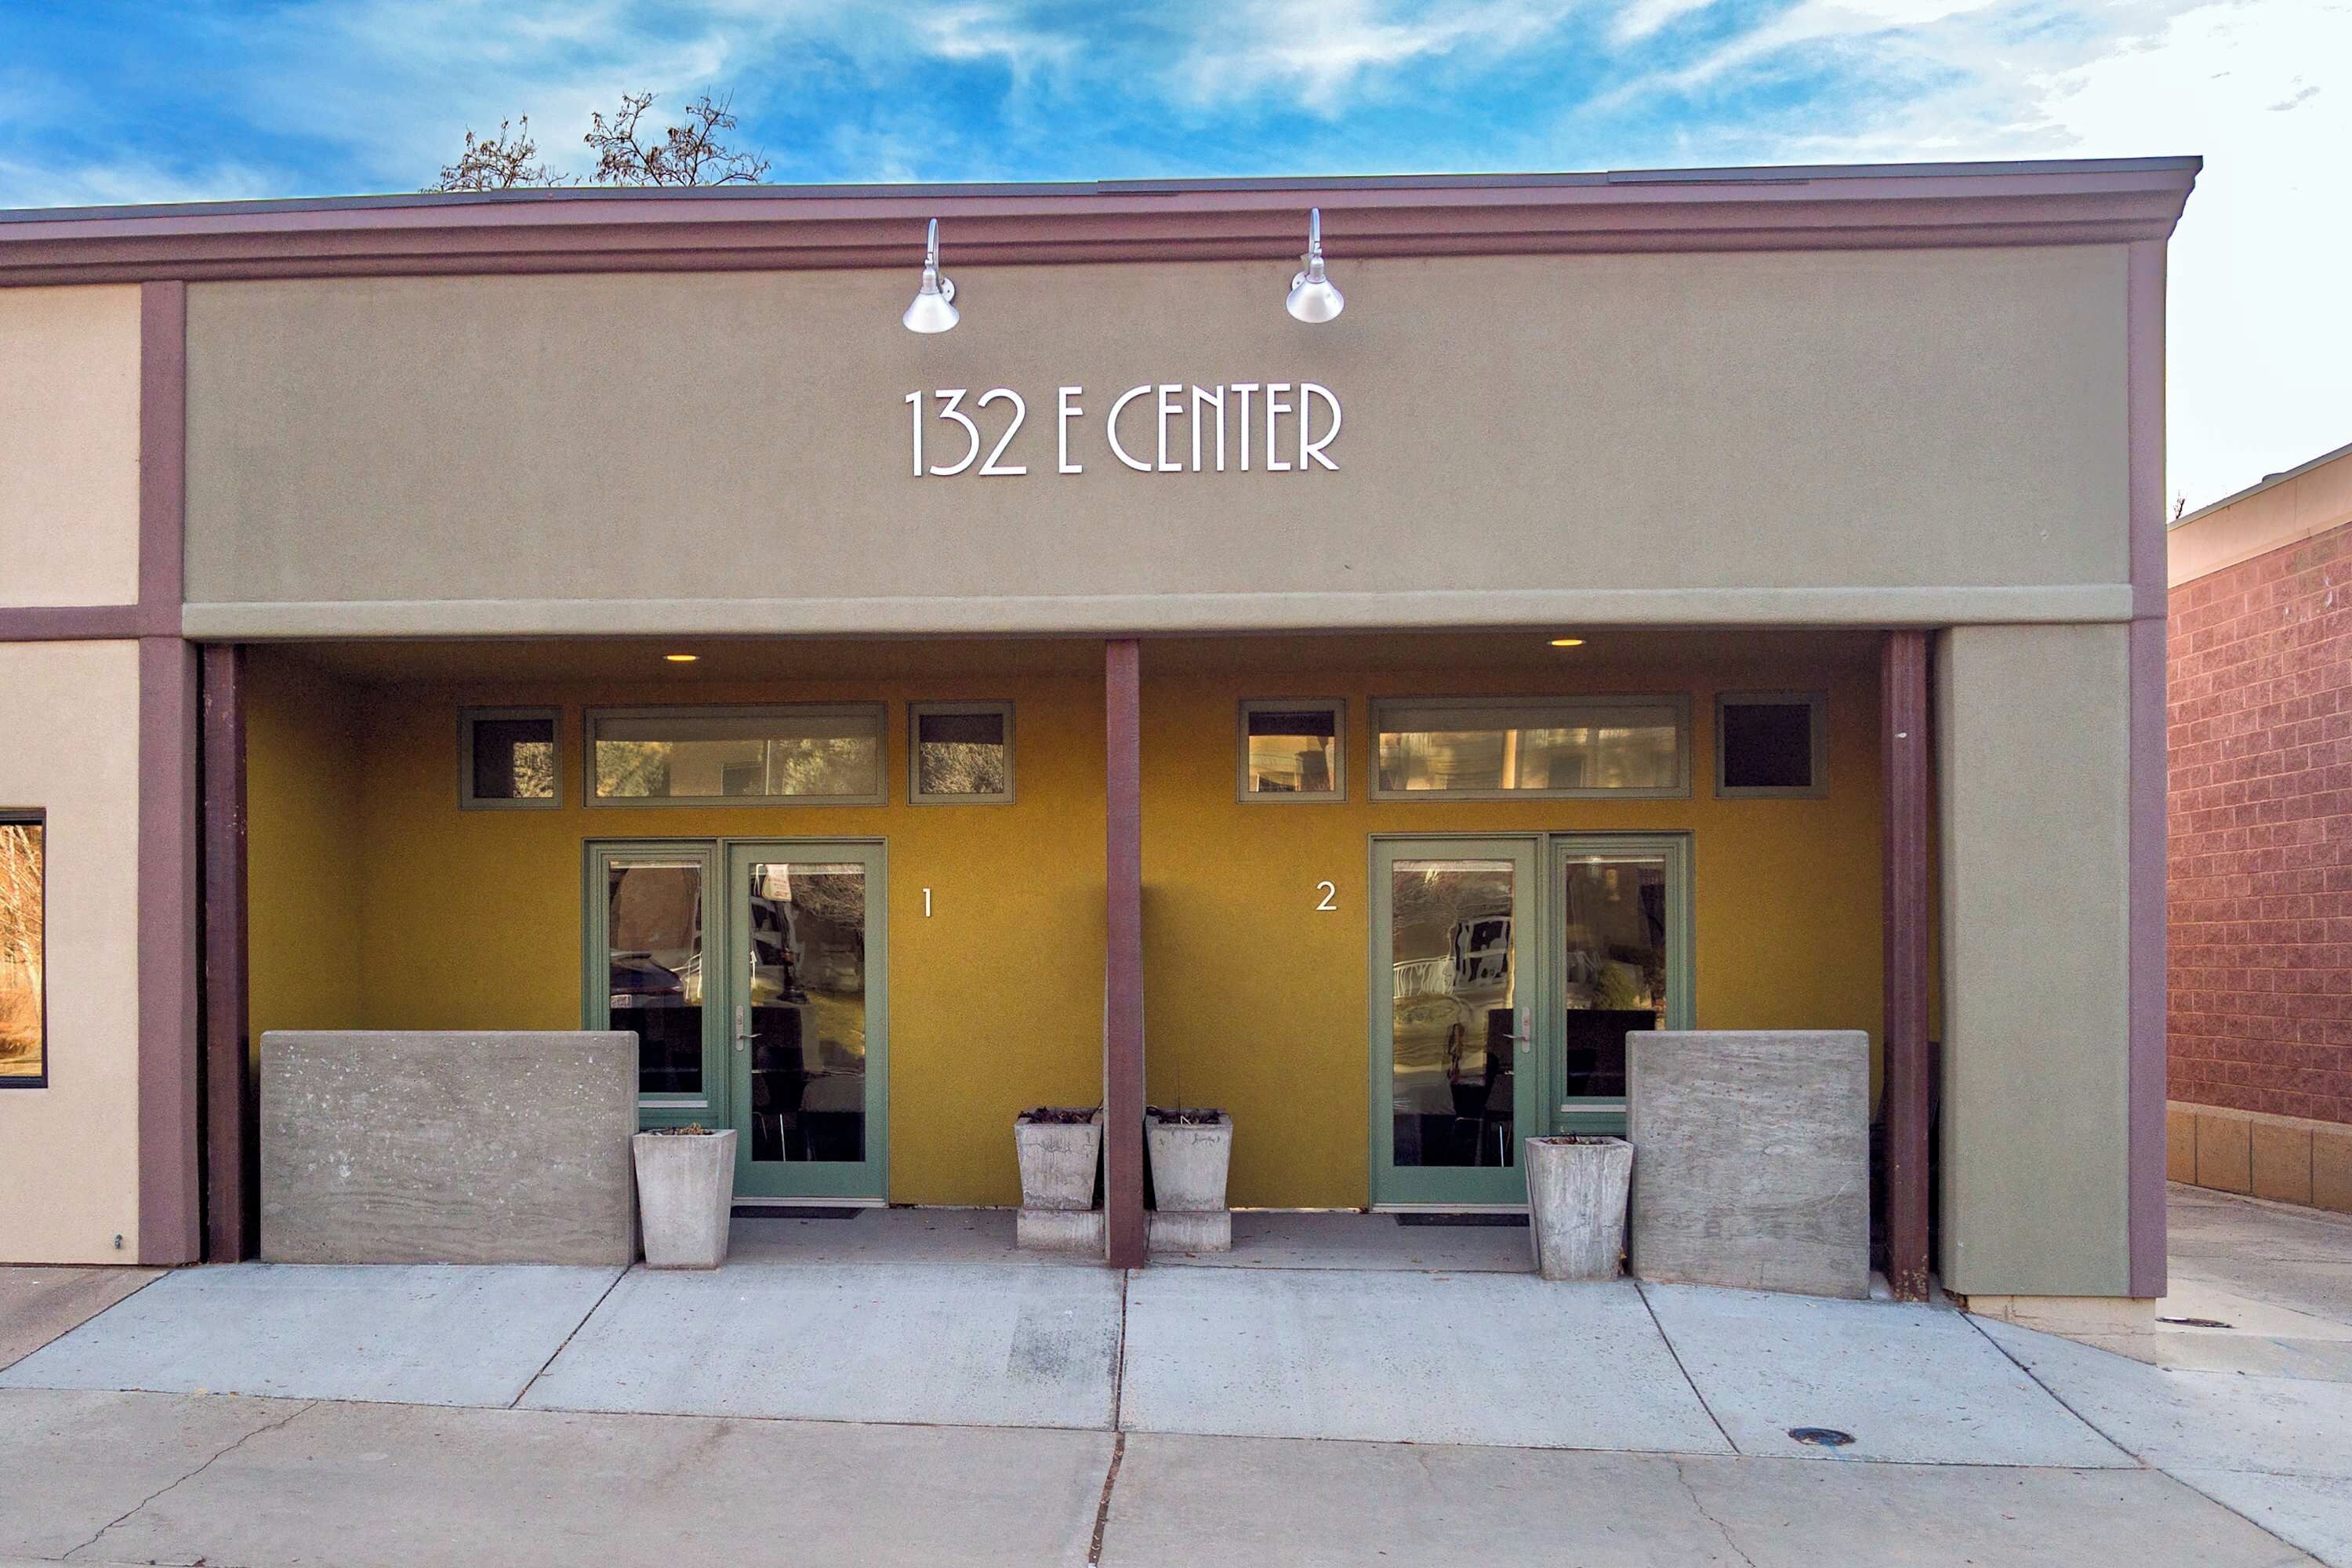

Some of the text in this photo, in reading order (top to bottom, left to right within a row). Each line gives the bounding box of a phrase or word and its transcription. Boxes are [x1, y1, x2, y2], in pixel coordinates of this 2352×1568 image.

[905, 383, 1342, 476] 132 E CENTER
[922, 887, 931, 917] 1
[1316, 880, 1338, 911] 2
